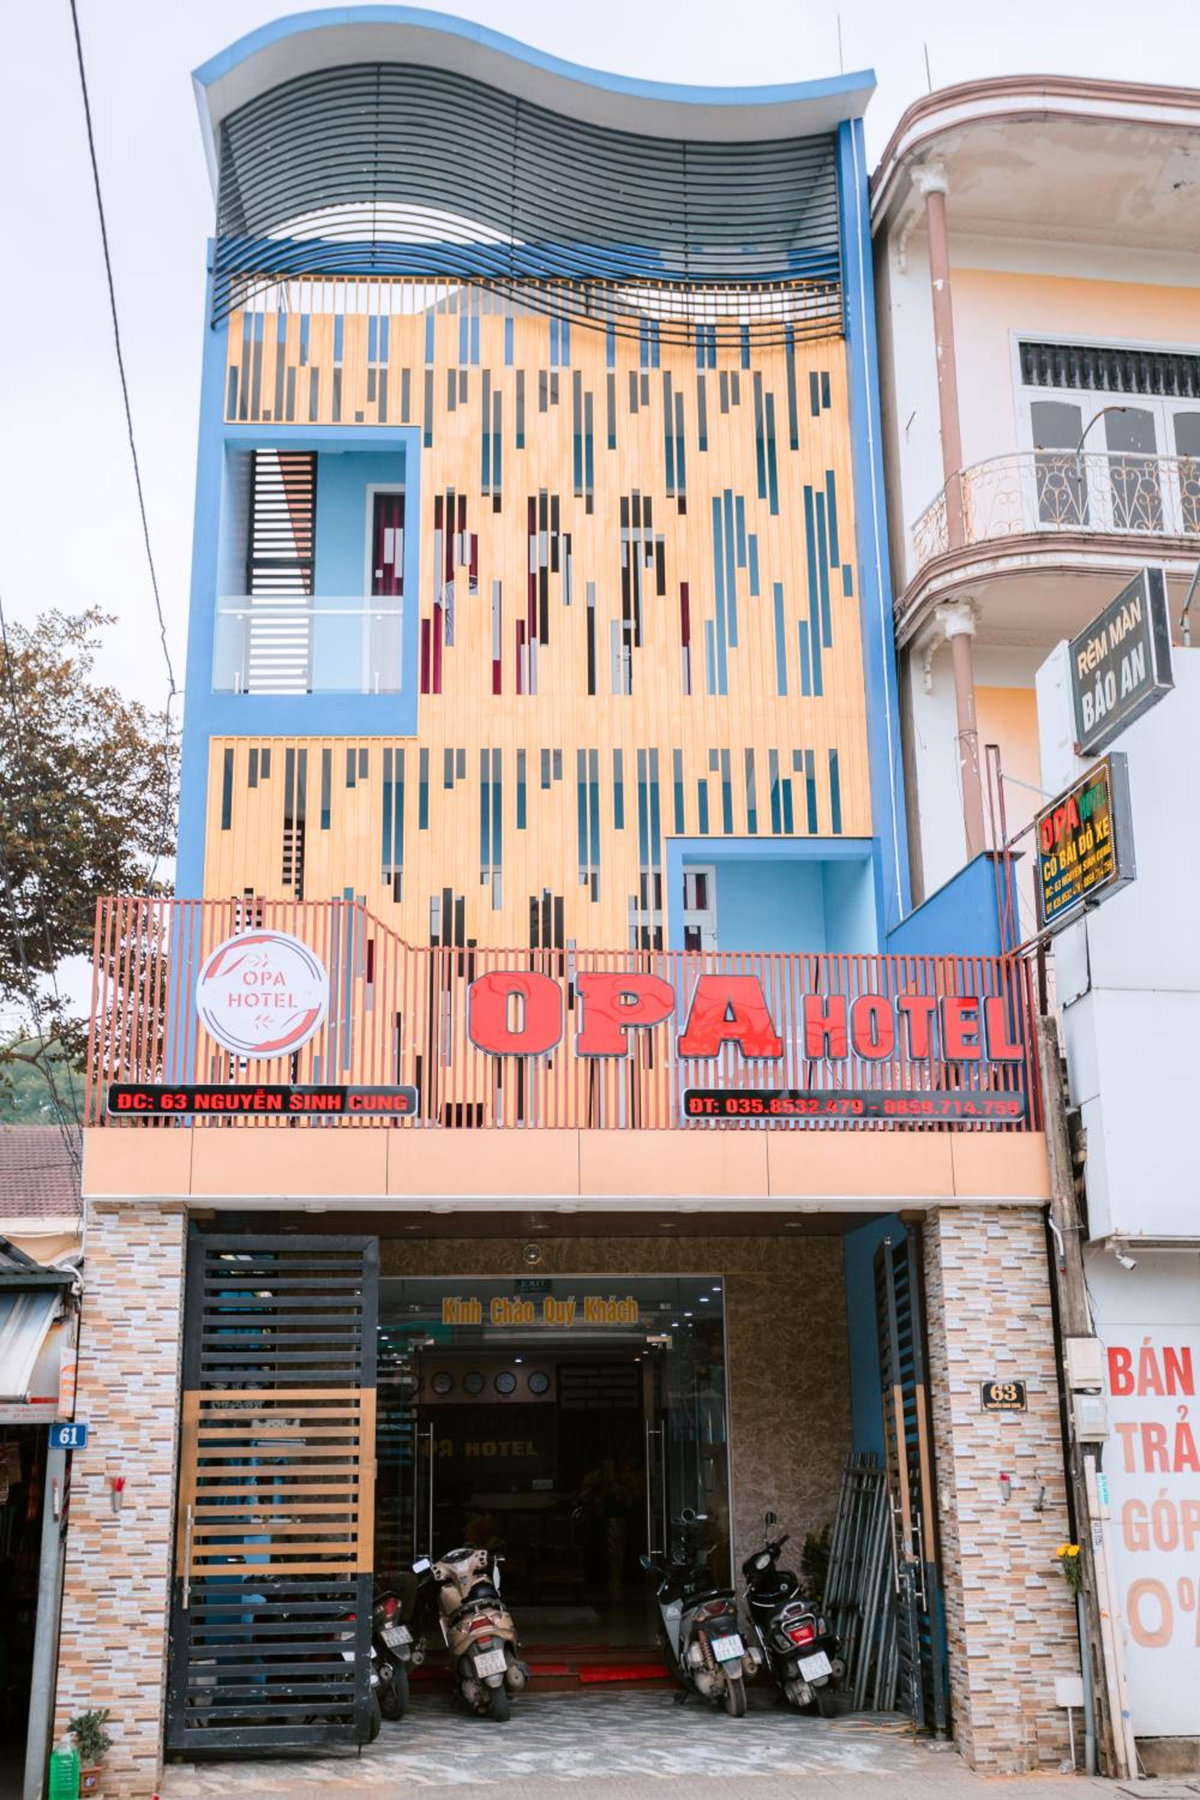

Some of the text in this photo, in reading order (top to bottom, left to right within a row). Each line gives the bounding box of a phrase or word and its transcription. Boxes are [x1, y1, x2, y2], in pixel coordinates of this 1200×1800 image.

[1078, 596, 1142, 680] RÈM MÀN
[1082, 641, 1146, 733] BẢO AN
[1040, 797, 1079, 850] OPA
[1095, 815, 1110, 842] XE
[243, 971, 286, 986] OPA
[228, 993, 298, 1008] HOTEL
[466, 970, 1025, 1064] OPA HOTEL
[117, 1088, 409, 1111] ĐC: 63 NGUYỄN SINH CUNG
[689, 1098, 719, 1114] ĐT:
[442, 1295, 639, 1327] Kính Chào Quý Khách
[1107, 1336, 1195, 1397] BÁN
[990, 1383, 1017, 1401] 63
[59, 1427, 78, 1445] 61
[463, 1440, 538, 1457] HOTEL
[1114, 1404, 1200, 1473] TRẢ
[1121, 1488, 1200, 1552] GÓP
